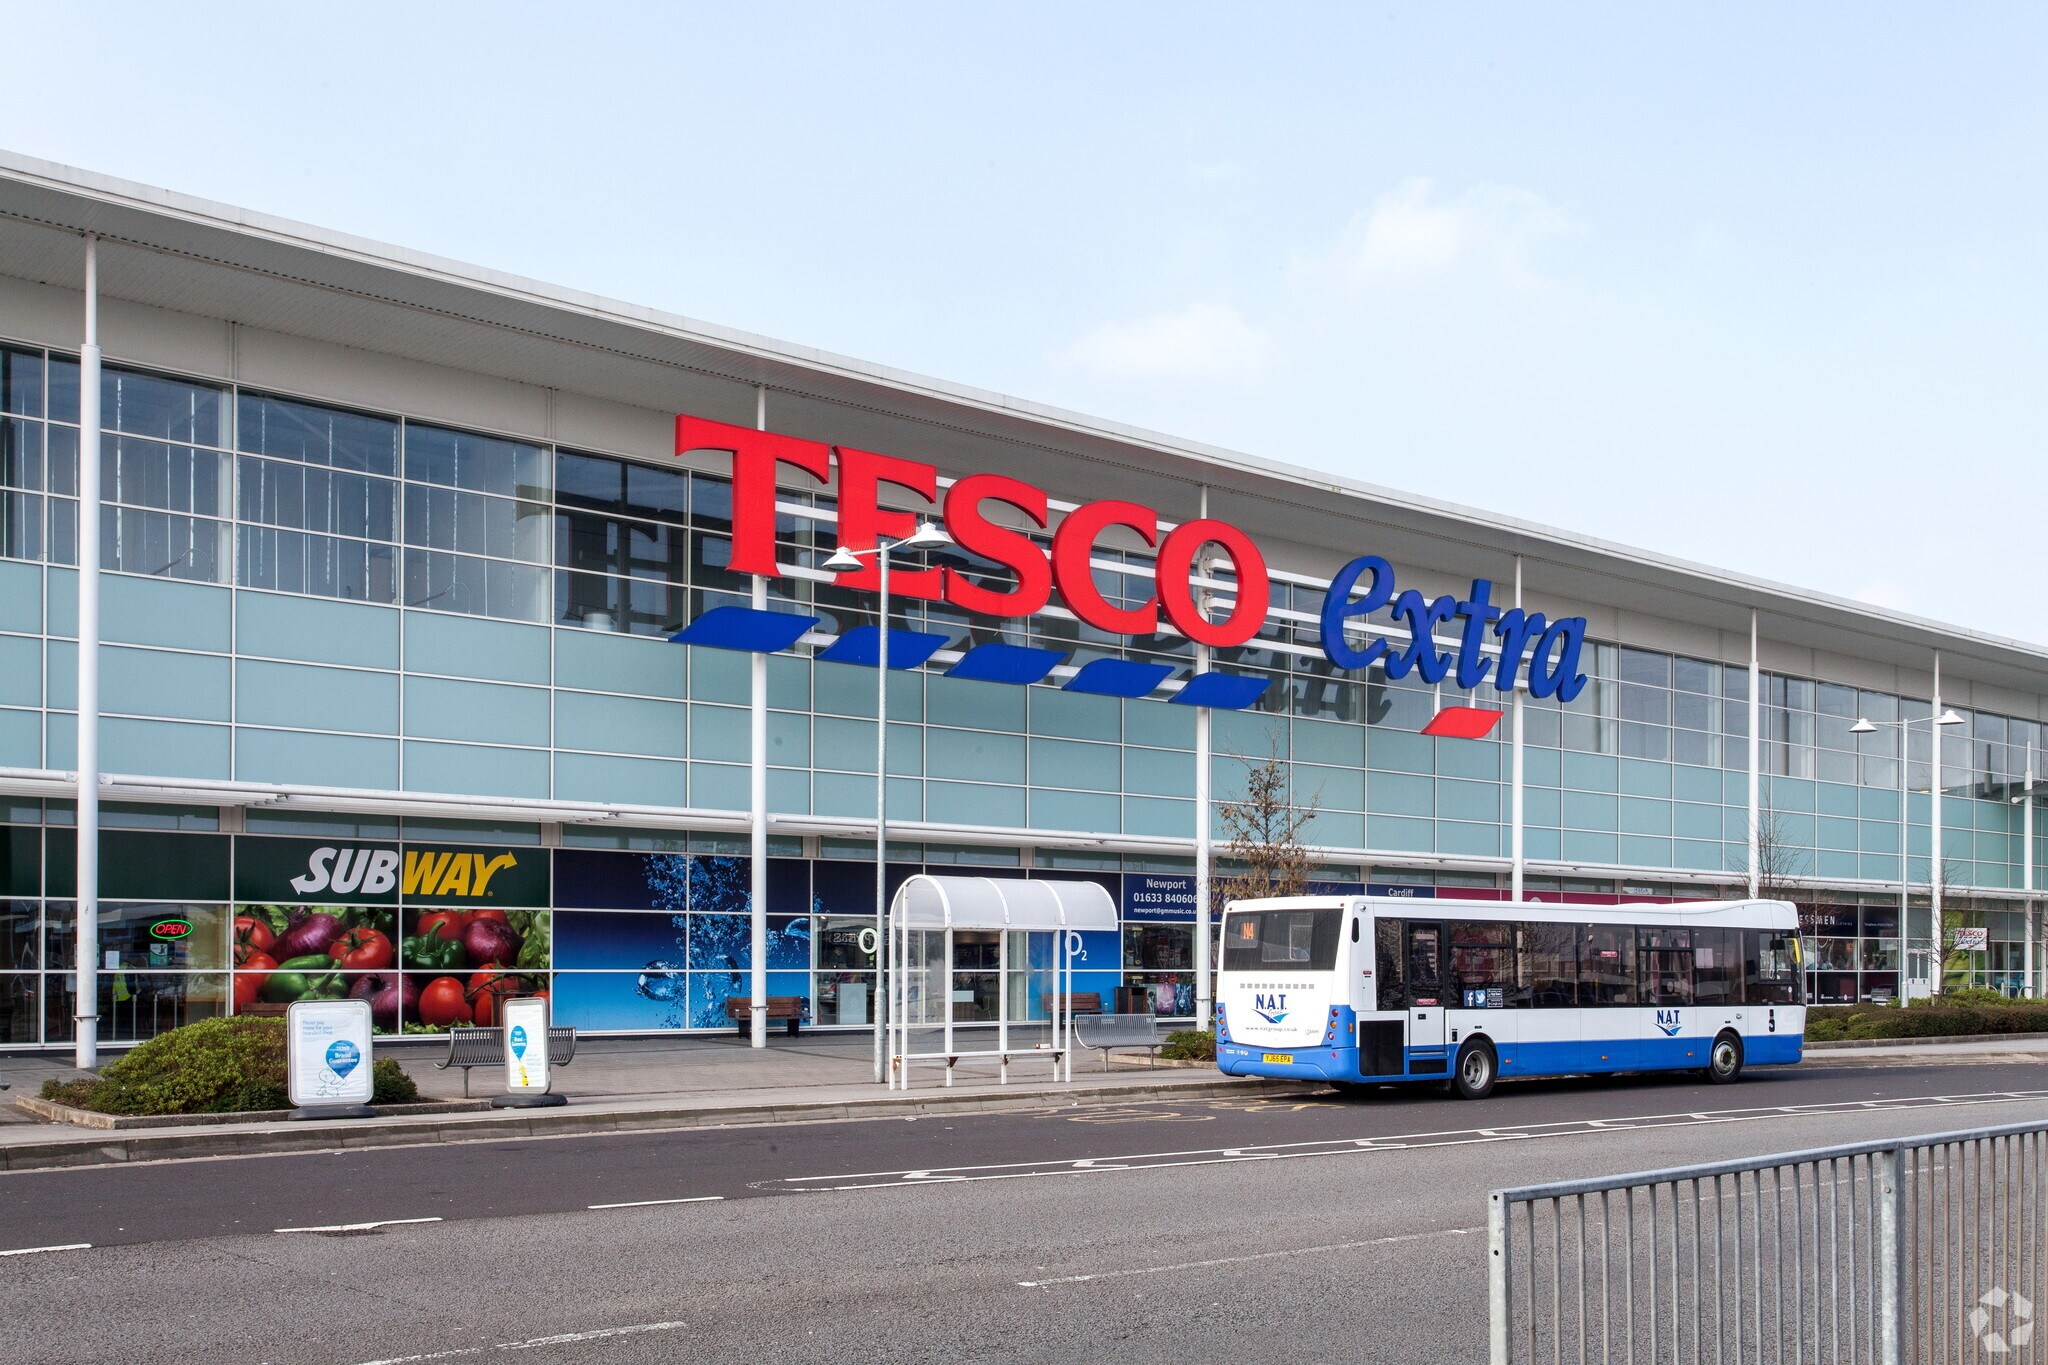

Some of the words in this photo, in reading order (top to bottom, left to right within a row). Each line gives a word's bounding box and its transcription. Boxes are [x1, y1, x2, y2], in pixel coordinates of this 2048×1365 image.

[675, 413, 1270, 648] TESCO
[1320, 555, 1588, 702] extra
[290, 846, 518, 897] SUBWAY
[1146, 878, 1187, 890] Newport
[1133, 892, 1162, 903] 01633
[1388, 888, 1414, 898] Cardiff
[1133, 907, 1197, 915] newport@gmmusic.co.u
[155, 924, 187, 935] OPEN
[1243, 922, 1255, 940] N4
[1255, 994, 1287, 1010] N.A.T.
